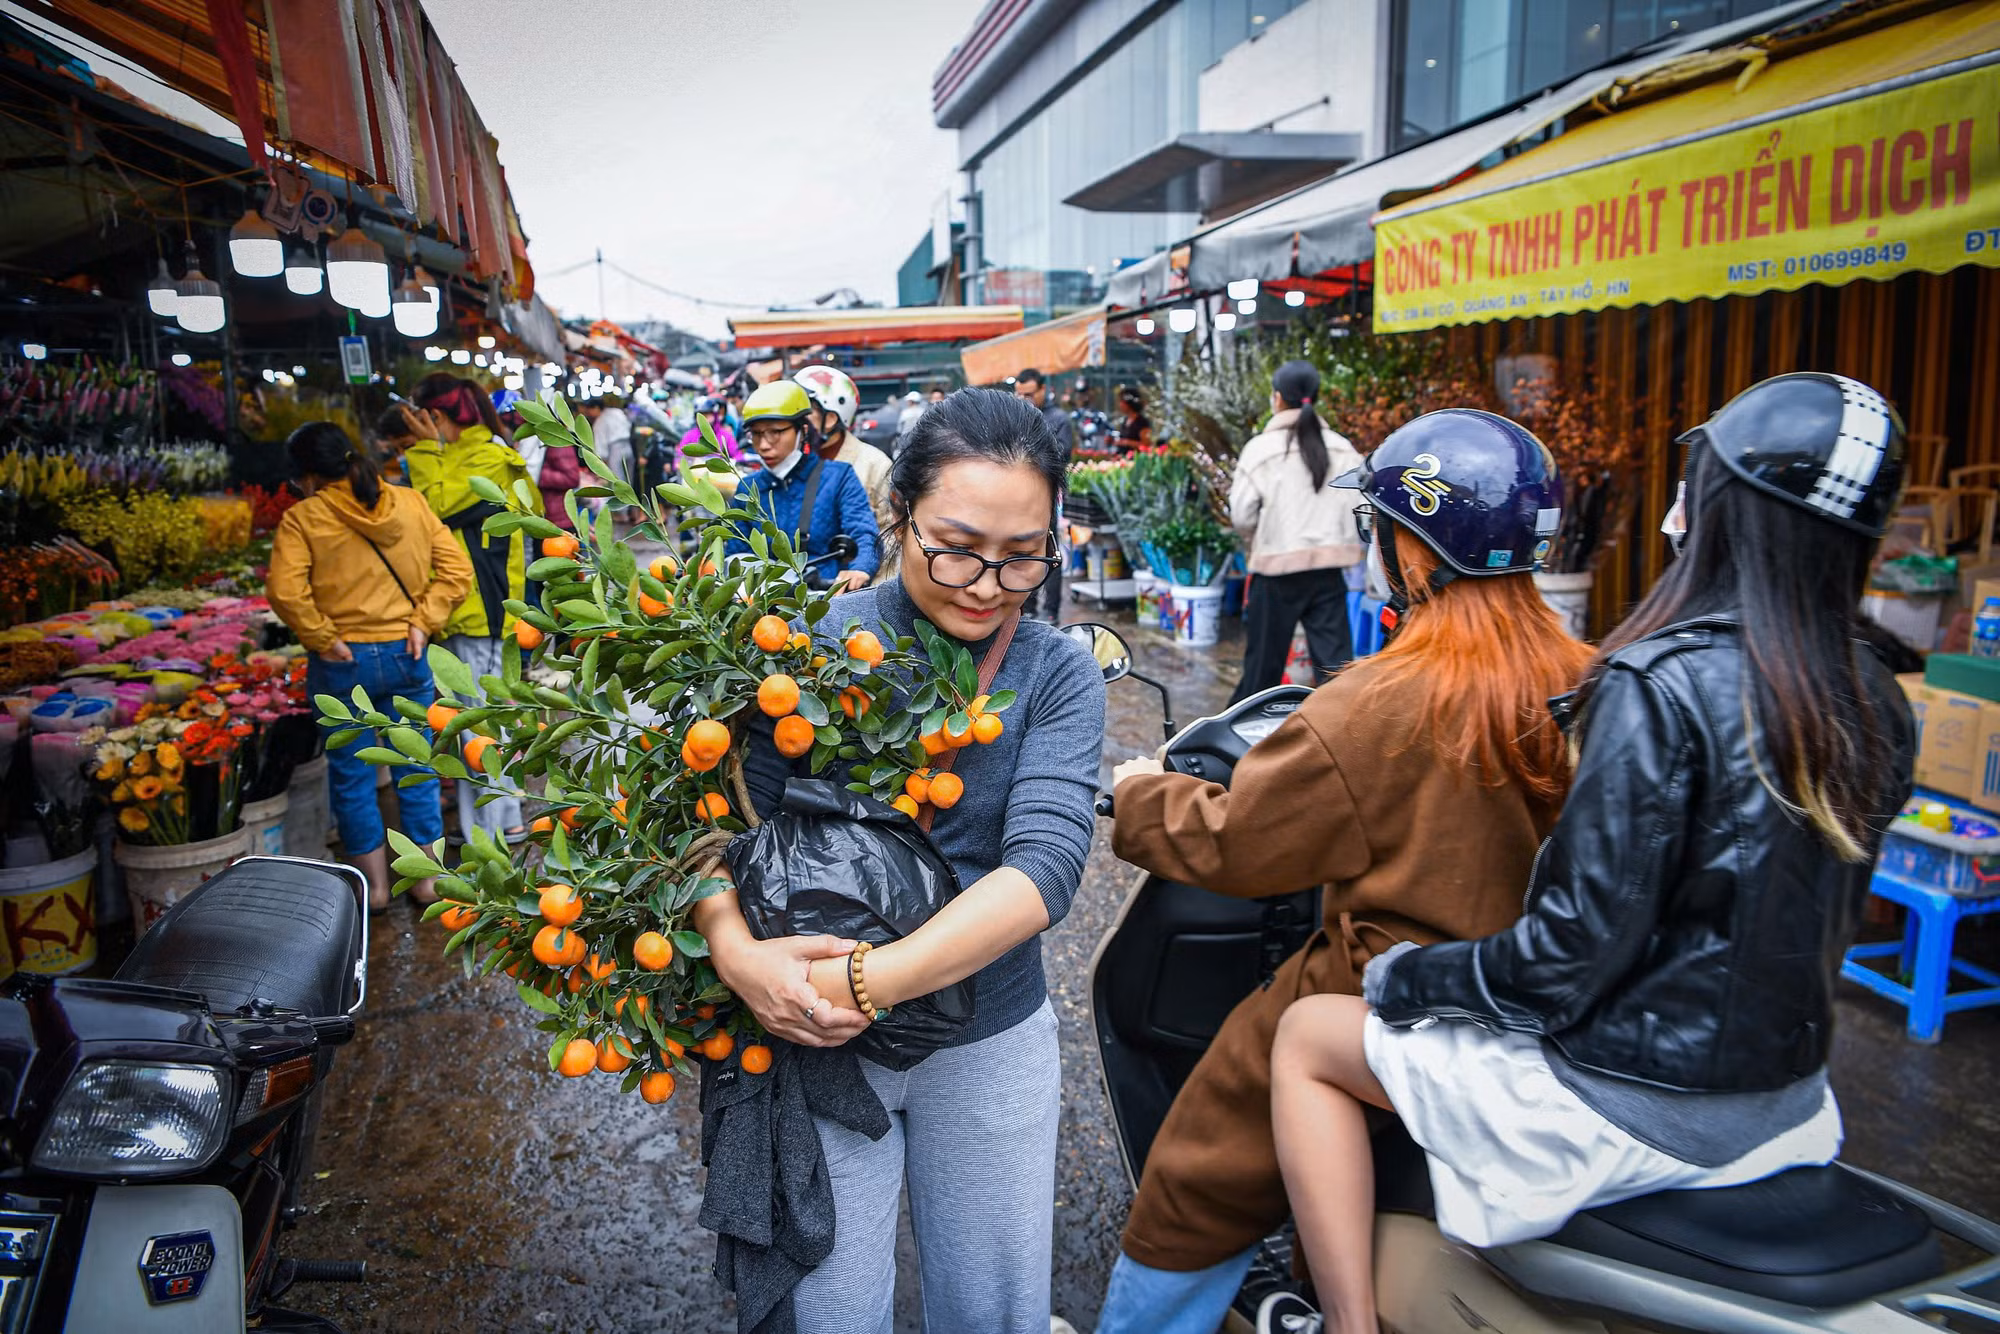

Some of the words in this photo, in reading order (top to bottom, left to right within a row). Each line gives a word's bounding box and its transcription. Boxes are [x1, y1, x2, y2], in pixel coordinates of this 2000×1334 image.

[1384, 234, 1442, 295] CÔNG
[1451, 230, 1478, 285] TY
[1488, 210, 1563, 279] TNHH
[1573, 178, 1667, 266] PHÁT
[1680, 128, 1813, 249] TRIỂN
[1830, 118, 1974, 238] DỊCH
[1728, 259, 1778, 282] MST:
[1784, 241, 1908, 275] 010699849
[1607, 281, 1630, 296] HN
[155, 1242, 208, 1264] ECONO
[156, 1255, 212, 1276] POWER
